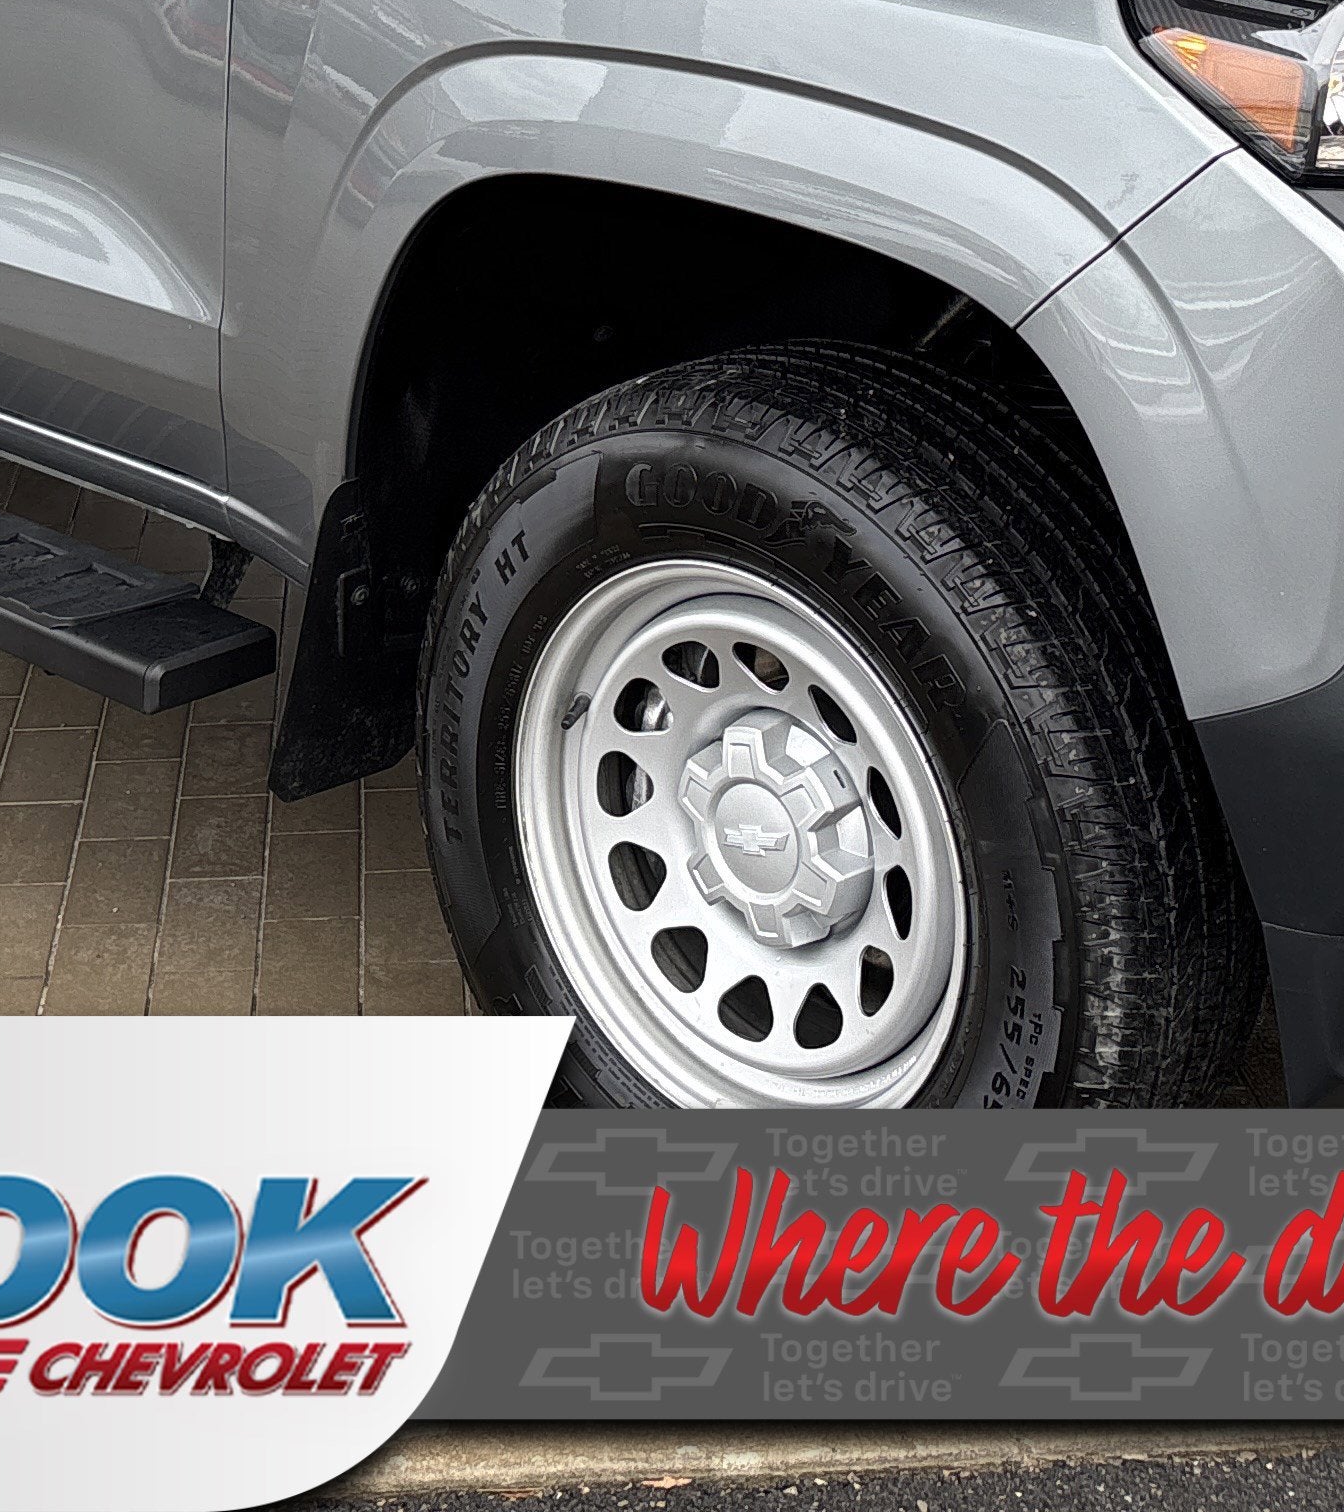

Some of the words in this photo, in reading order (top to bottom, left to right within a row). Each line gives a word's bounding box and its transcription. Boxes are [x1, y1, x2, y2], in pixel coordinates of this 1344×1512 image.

[494, 530, 530, 586] HT
[1028, 1013, 1043, 1046] TPC
[1016, 1055, 1035, 1101] SPEC
